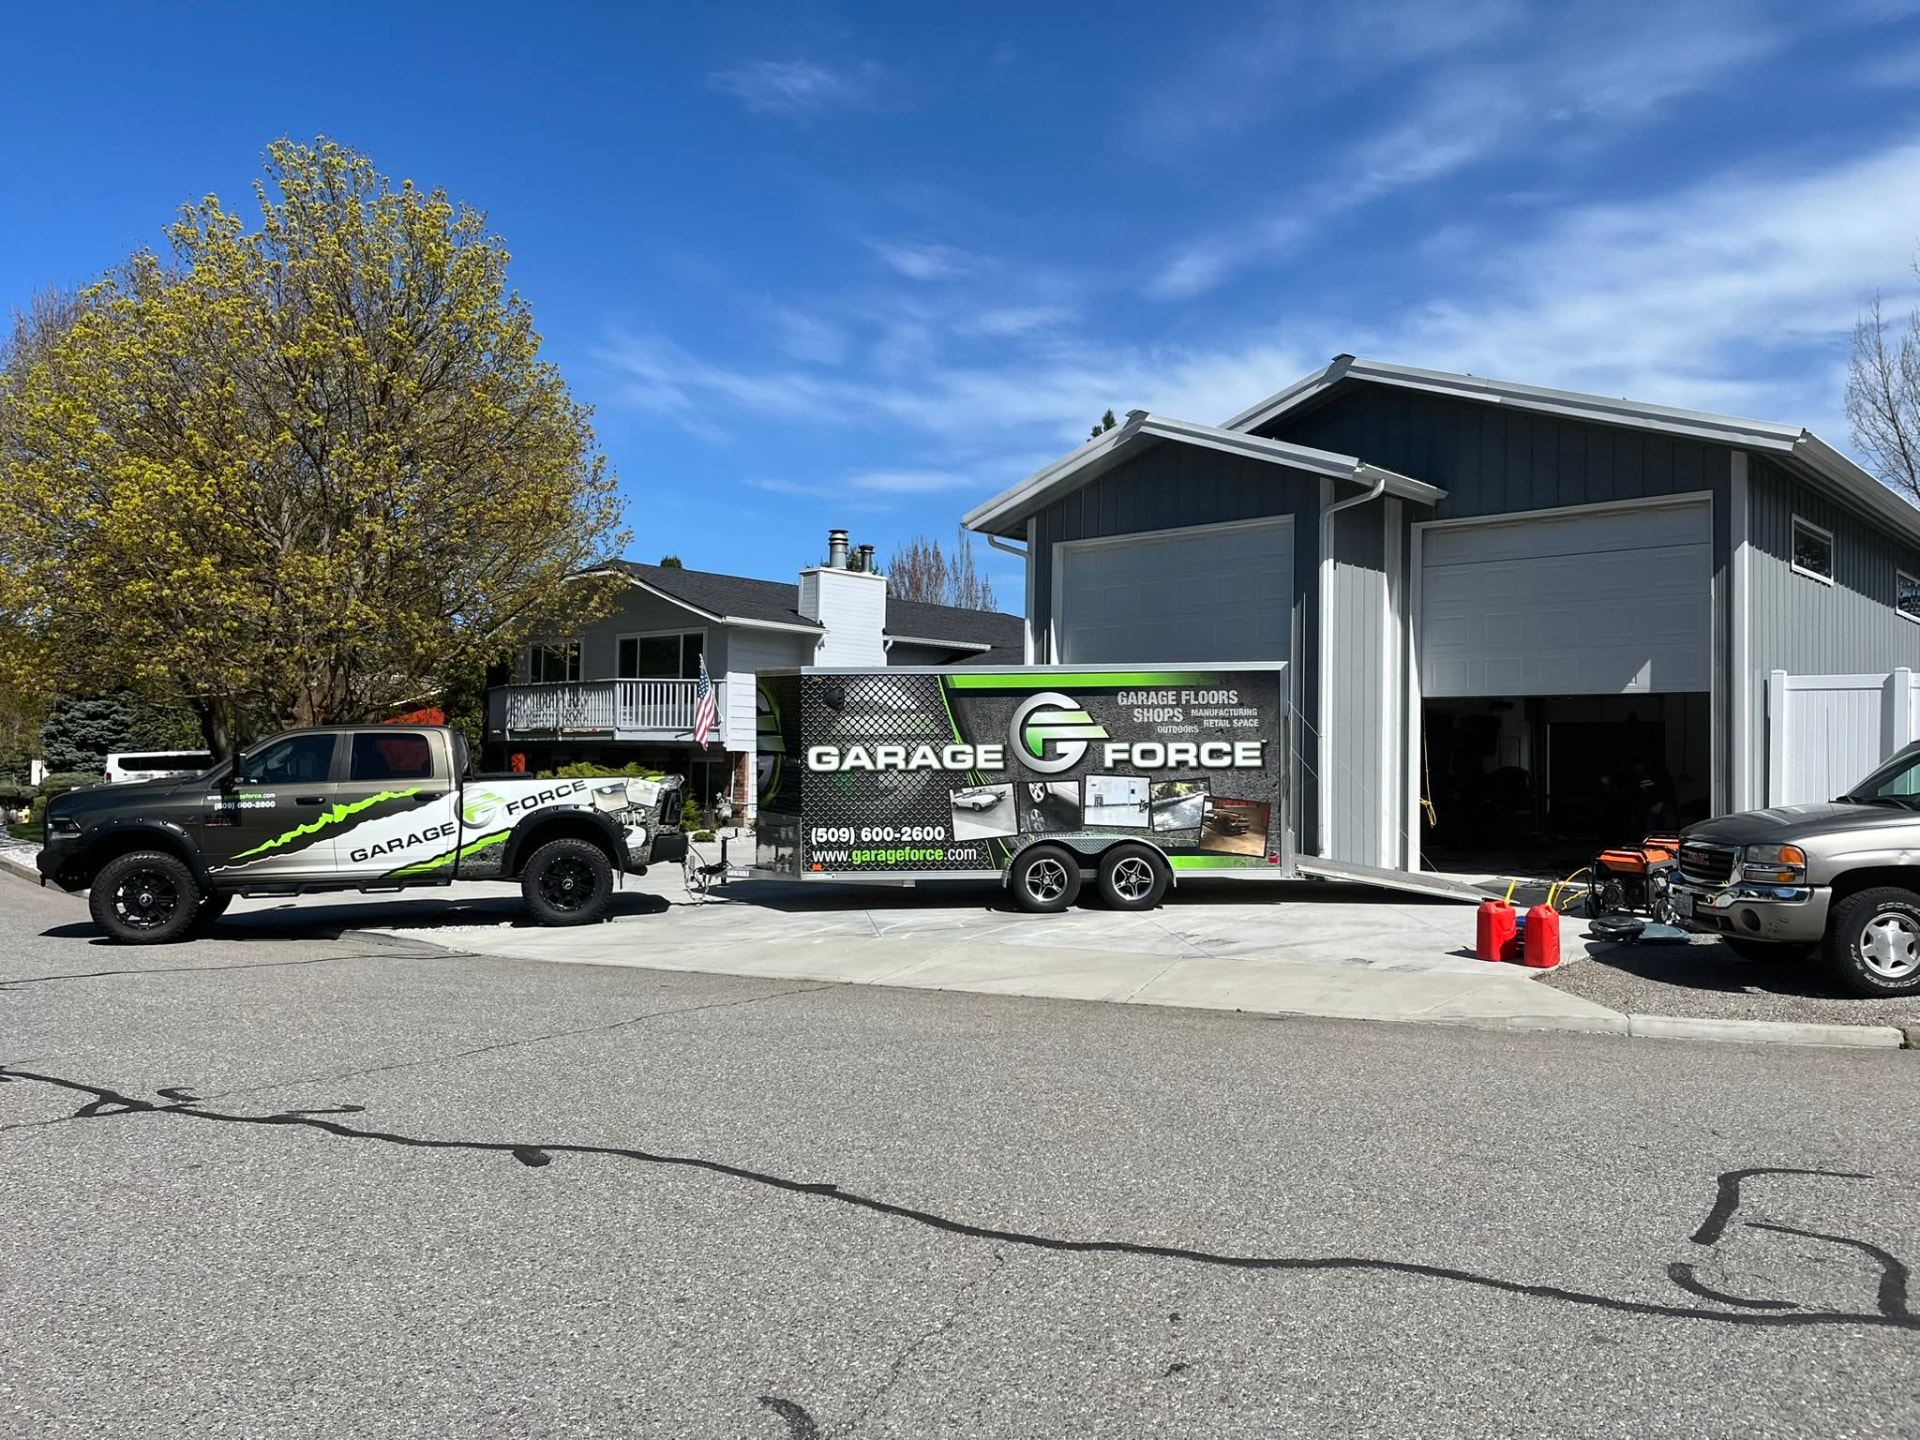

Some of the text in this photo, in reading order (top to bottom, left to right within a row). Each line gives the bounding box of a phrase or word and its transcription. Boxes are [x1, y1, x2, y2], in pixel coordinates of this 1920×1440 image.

[1117, 690, 1239, 706] GARAGE FLOORS
[1133, 708, 1184, 723] SHOPS
[1191, 708, 1258, 717] MANUFACTURING
[1157, 725, 1199, 734] OUTDOORS
[1203, 718, 1259, 728] RETAIL SPACE
[807, 744, 1005, 772] GARAGE
[1104, 741, 1263, 768] FORCE
[350, 822, 456, 863] GARAGE
[506, 780, 587, 816] FORCE
[811, 826, 945, 845] (509) 600-2600
[812, 846, 977, 864] www.garageforce.com
